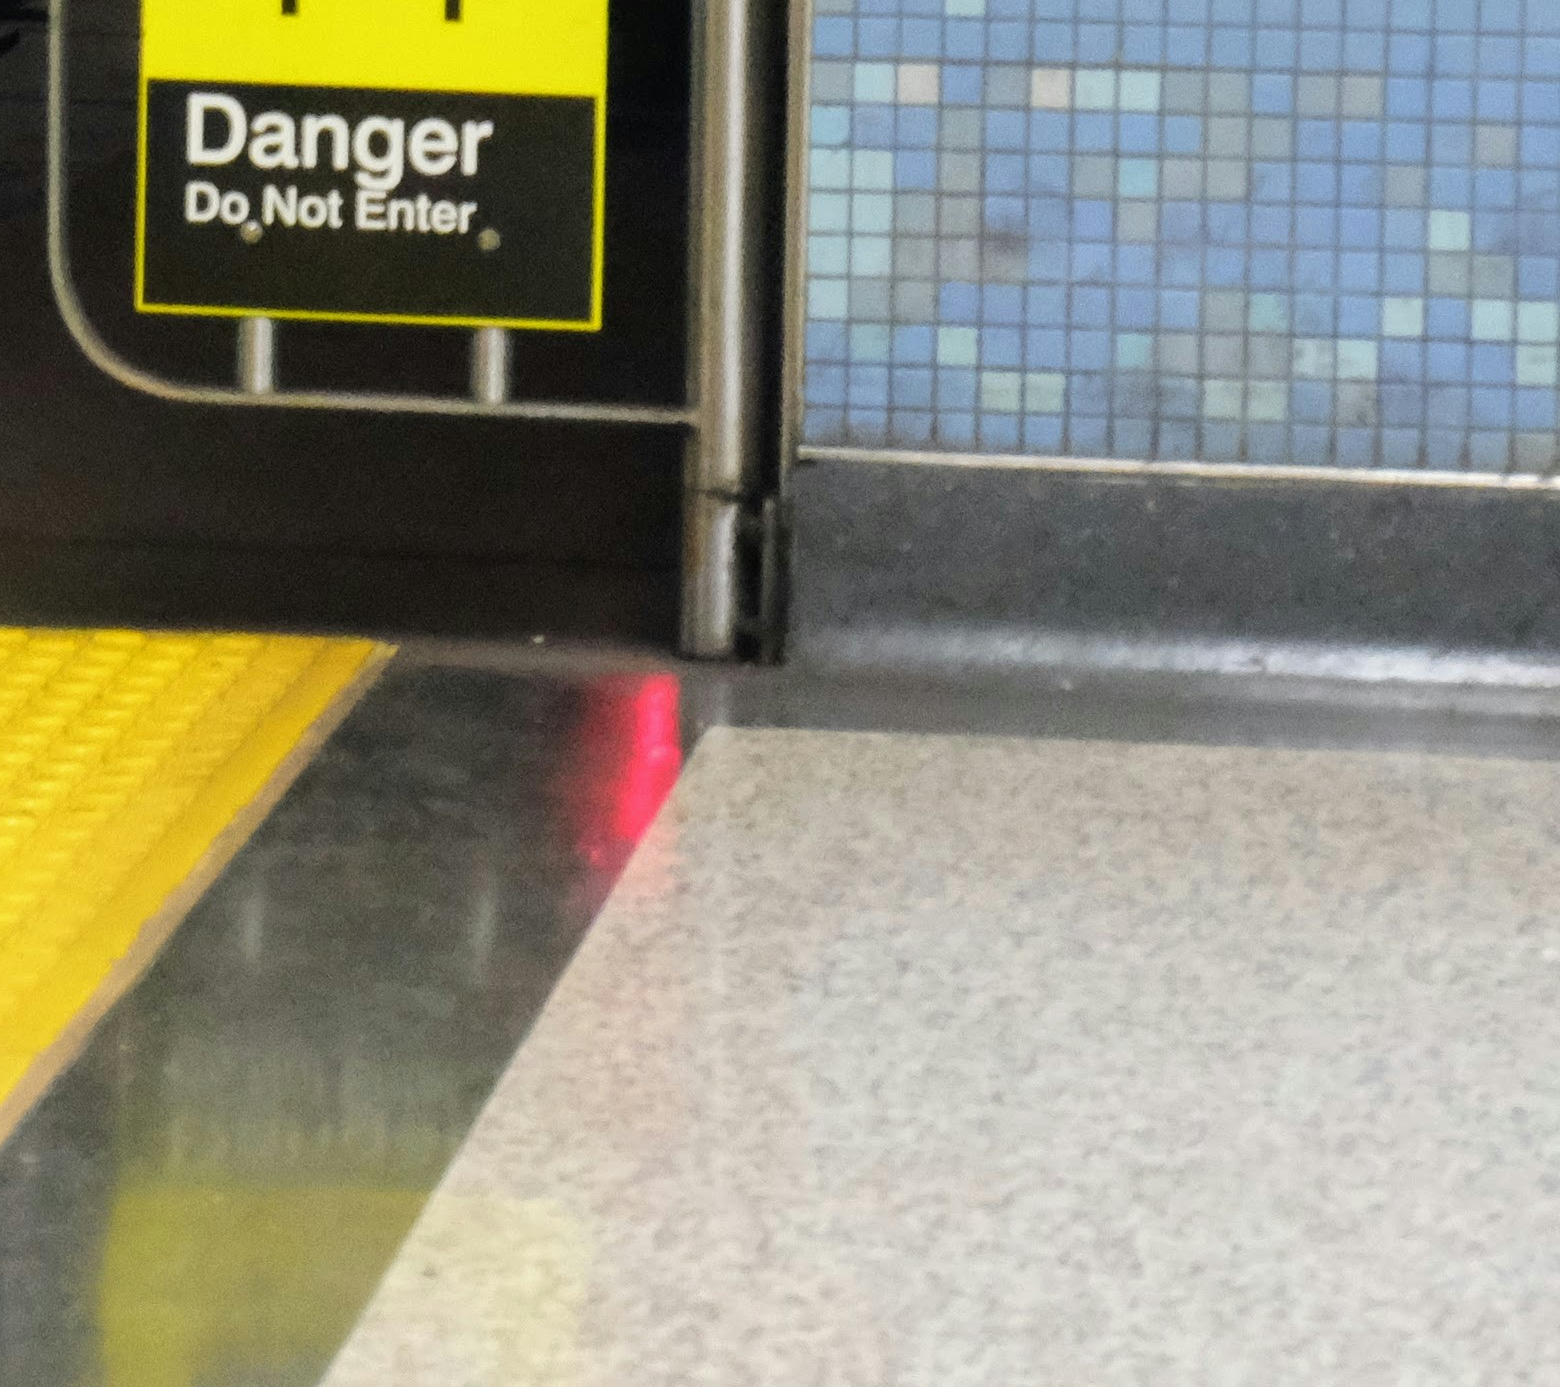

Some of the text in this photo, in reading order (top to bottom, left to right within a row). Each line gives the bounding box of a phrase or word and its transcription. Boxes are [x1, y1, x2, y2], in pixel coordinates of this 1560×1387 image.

[185, 91, 494, 191] Danger
[185, 180, 479, 235] Do Not Enter
